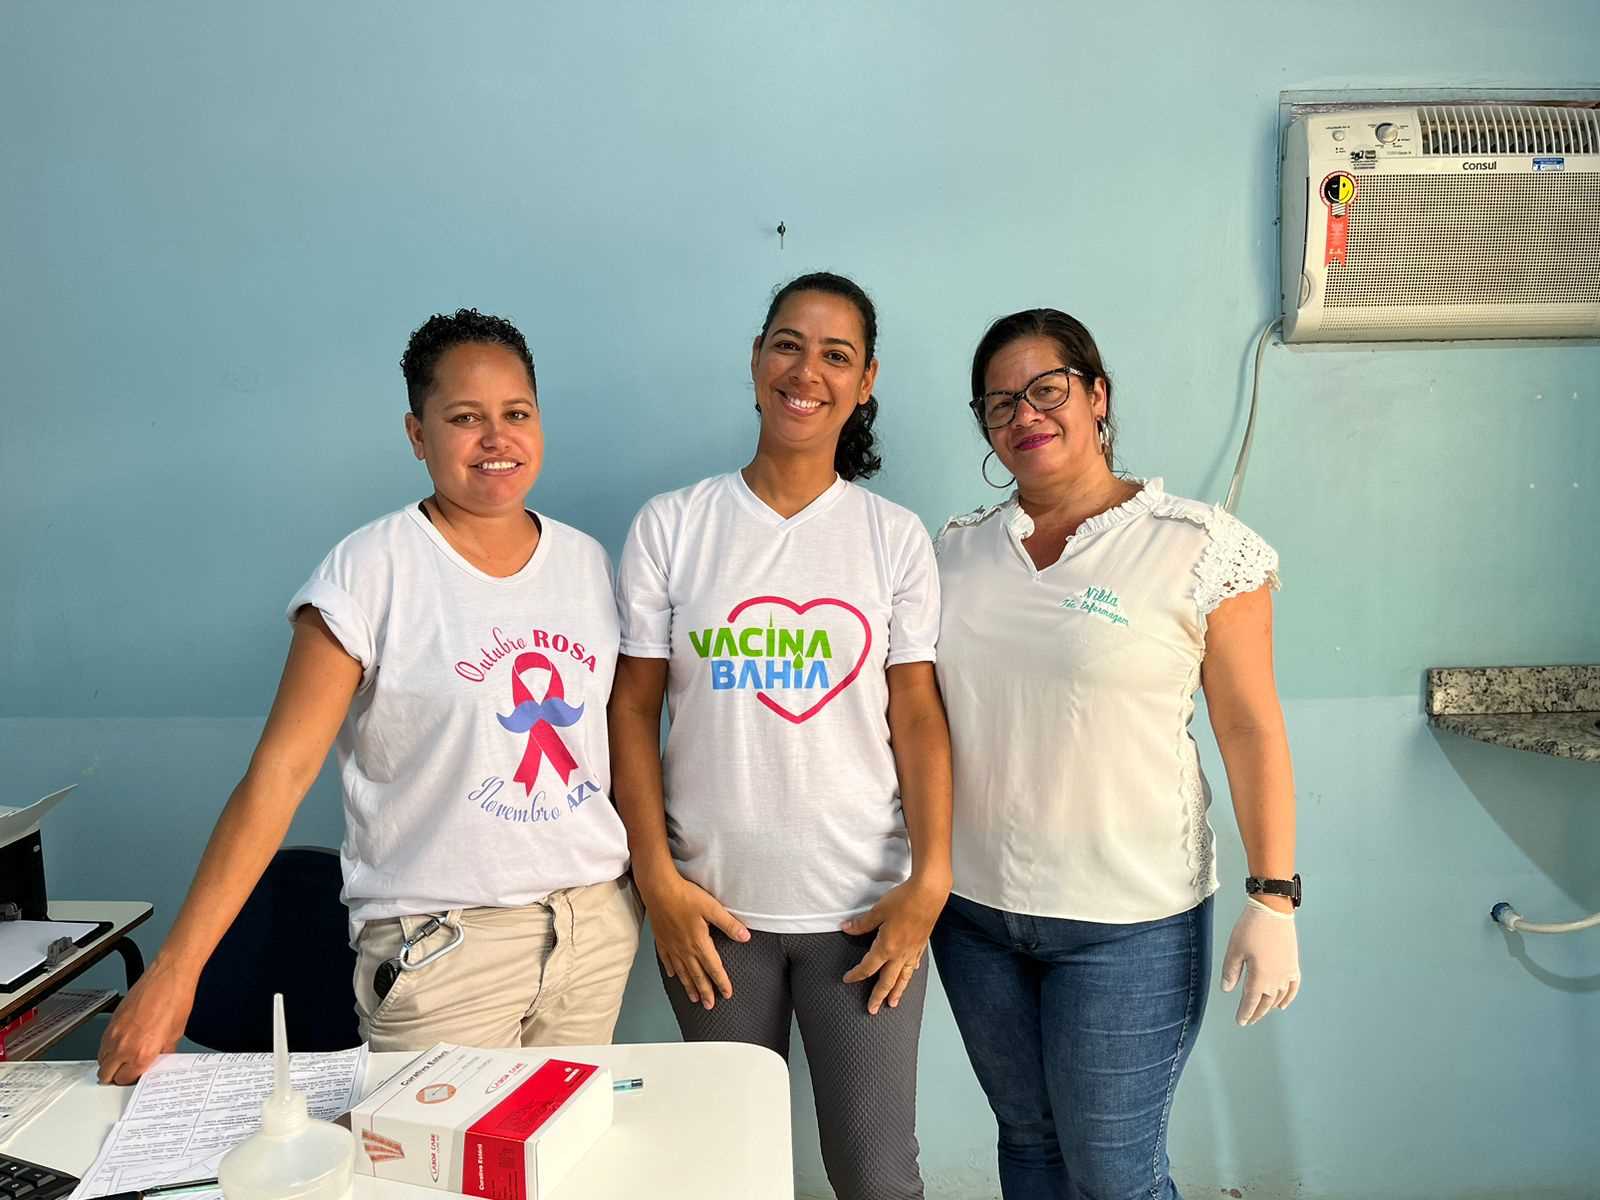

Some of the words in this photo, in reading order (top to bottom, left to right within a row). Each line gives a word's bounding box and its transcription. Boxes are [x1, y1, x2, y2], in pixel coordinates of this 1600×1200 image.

[1462, 161, 1497, 170] Consul
[1080, 587, 1118, 607] Nilda
[455, 627, 528, 683] Outubro
[533, 629, 597, 673] ROSA
[689, 622, 832, 658] VACINA
[711, 659, 830, 690] BAHIA
[467, 775, 560, 823] Novembro
[566, 775, 603, 813] AZU
